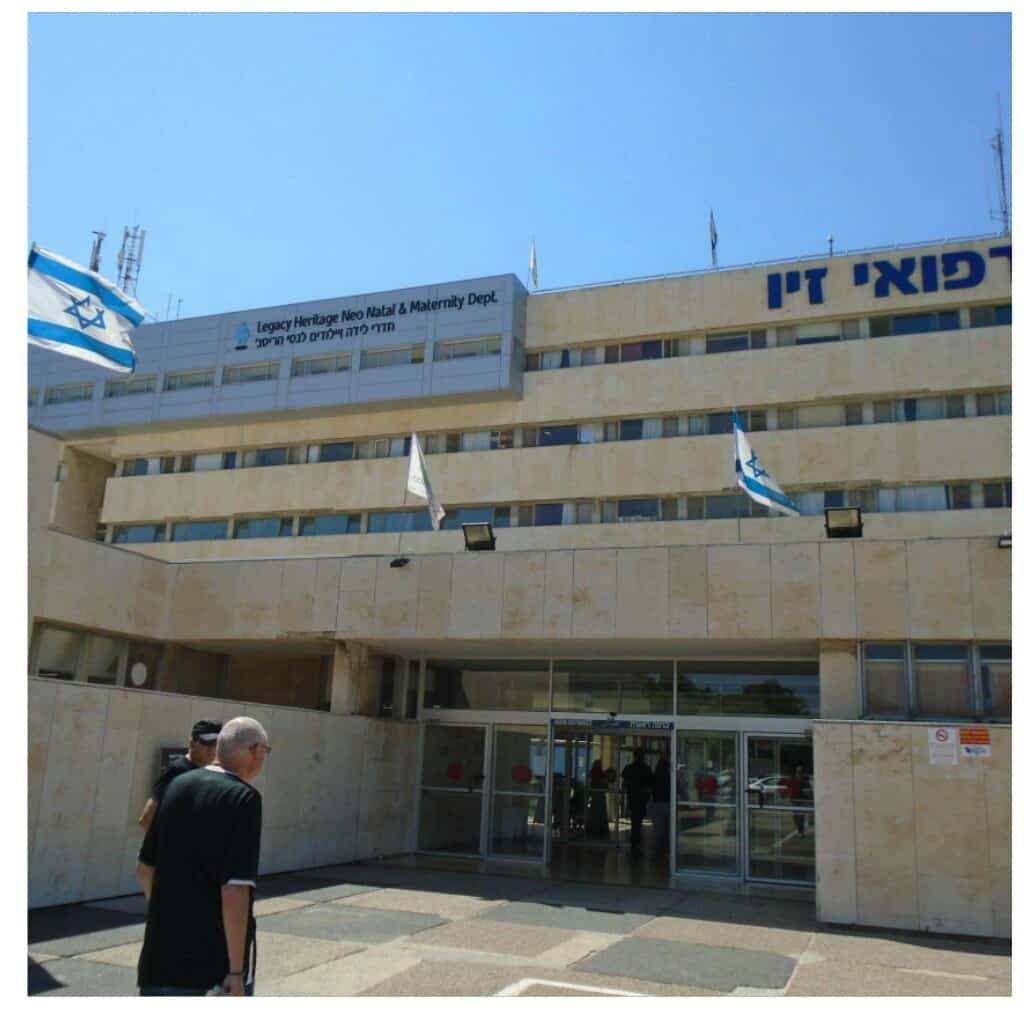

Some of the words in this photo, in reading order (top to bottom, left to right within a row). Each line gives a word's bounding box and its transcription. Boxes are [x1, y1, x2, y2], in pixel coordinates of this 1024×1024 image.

[767, 267, 829, 310] זיו
[256, 318, 292, 334] Legacy
[294, 312, 339, 329] Heritage
[341, 308, 364, 322] Neo
[366, 303, 396, 319] Natal
[398, 302, 406, 315] &
[409, 294, 465, 314] Maternity
